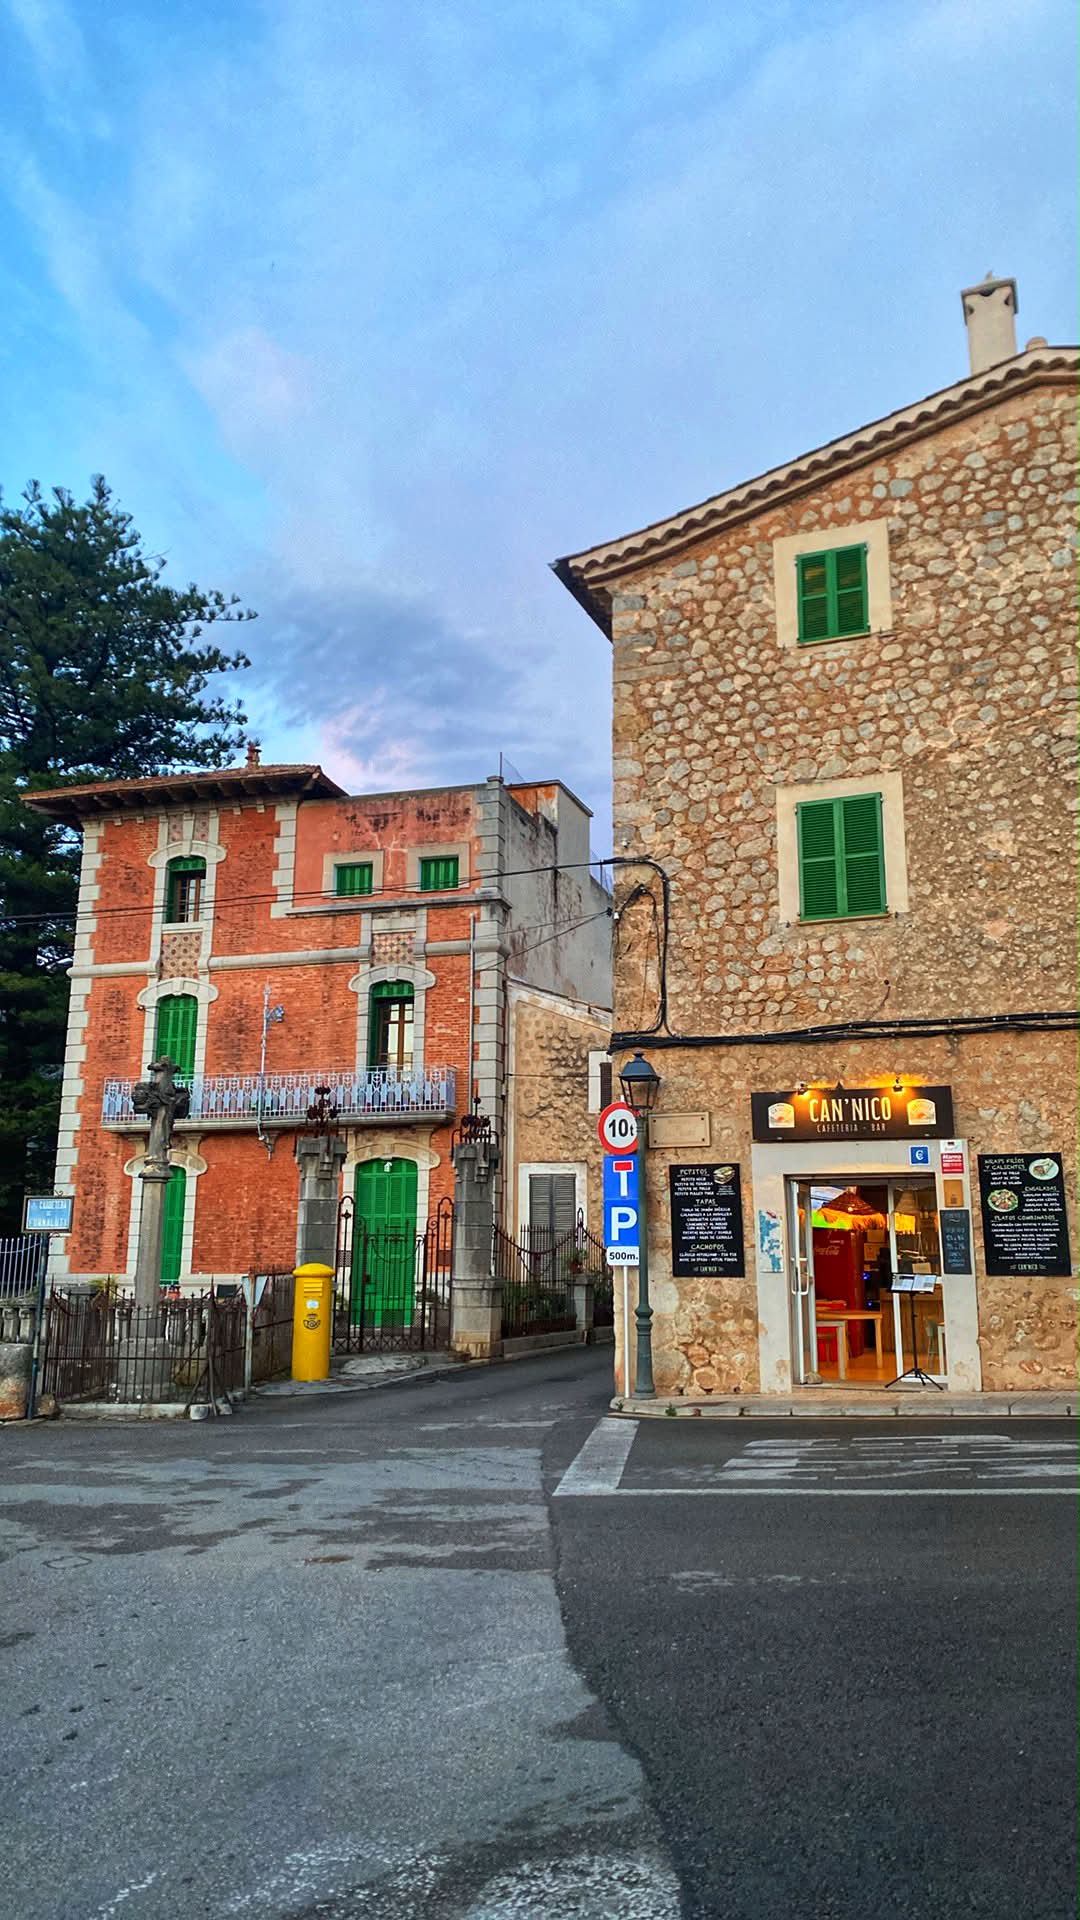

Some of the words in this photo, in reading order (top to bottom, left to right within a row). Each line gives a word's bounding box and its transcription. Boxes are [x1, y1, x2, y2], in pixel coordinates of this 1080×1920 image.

[810, 1096, 892, 1122] CAN'NICO
[816, 1124, 858, 1132] CAFETERIA
[872, 1123, 886, 1132] BAR
